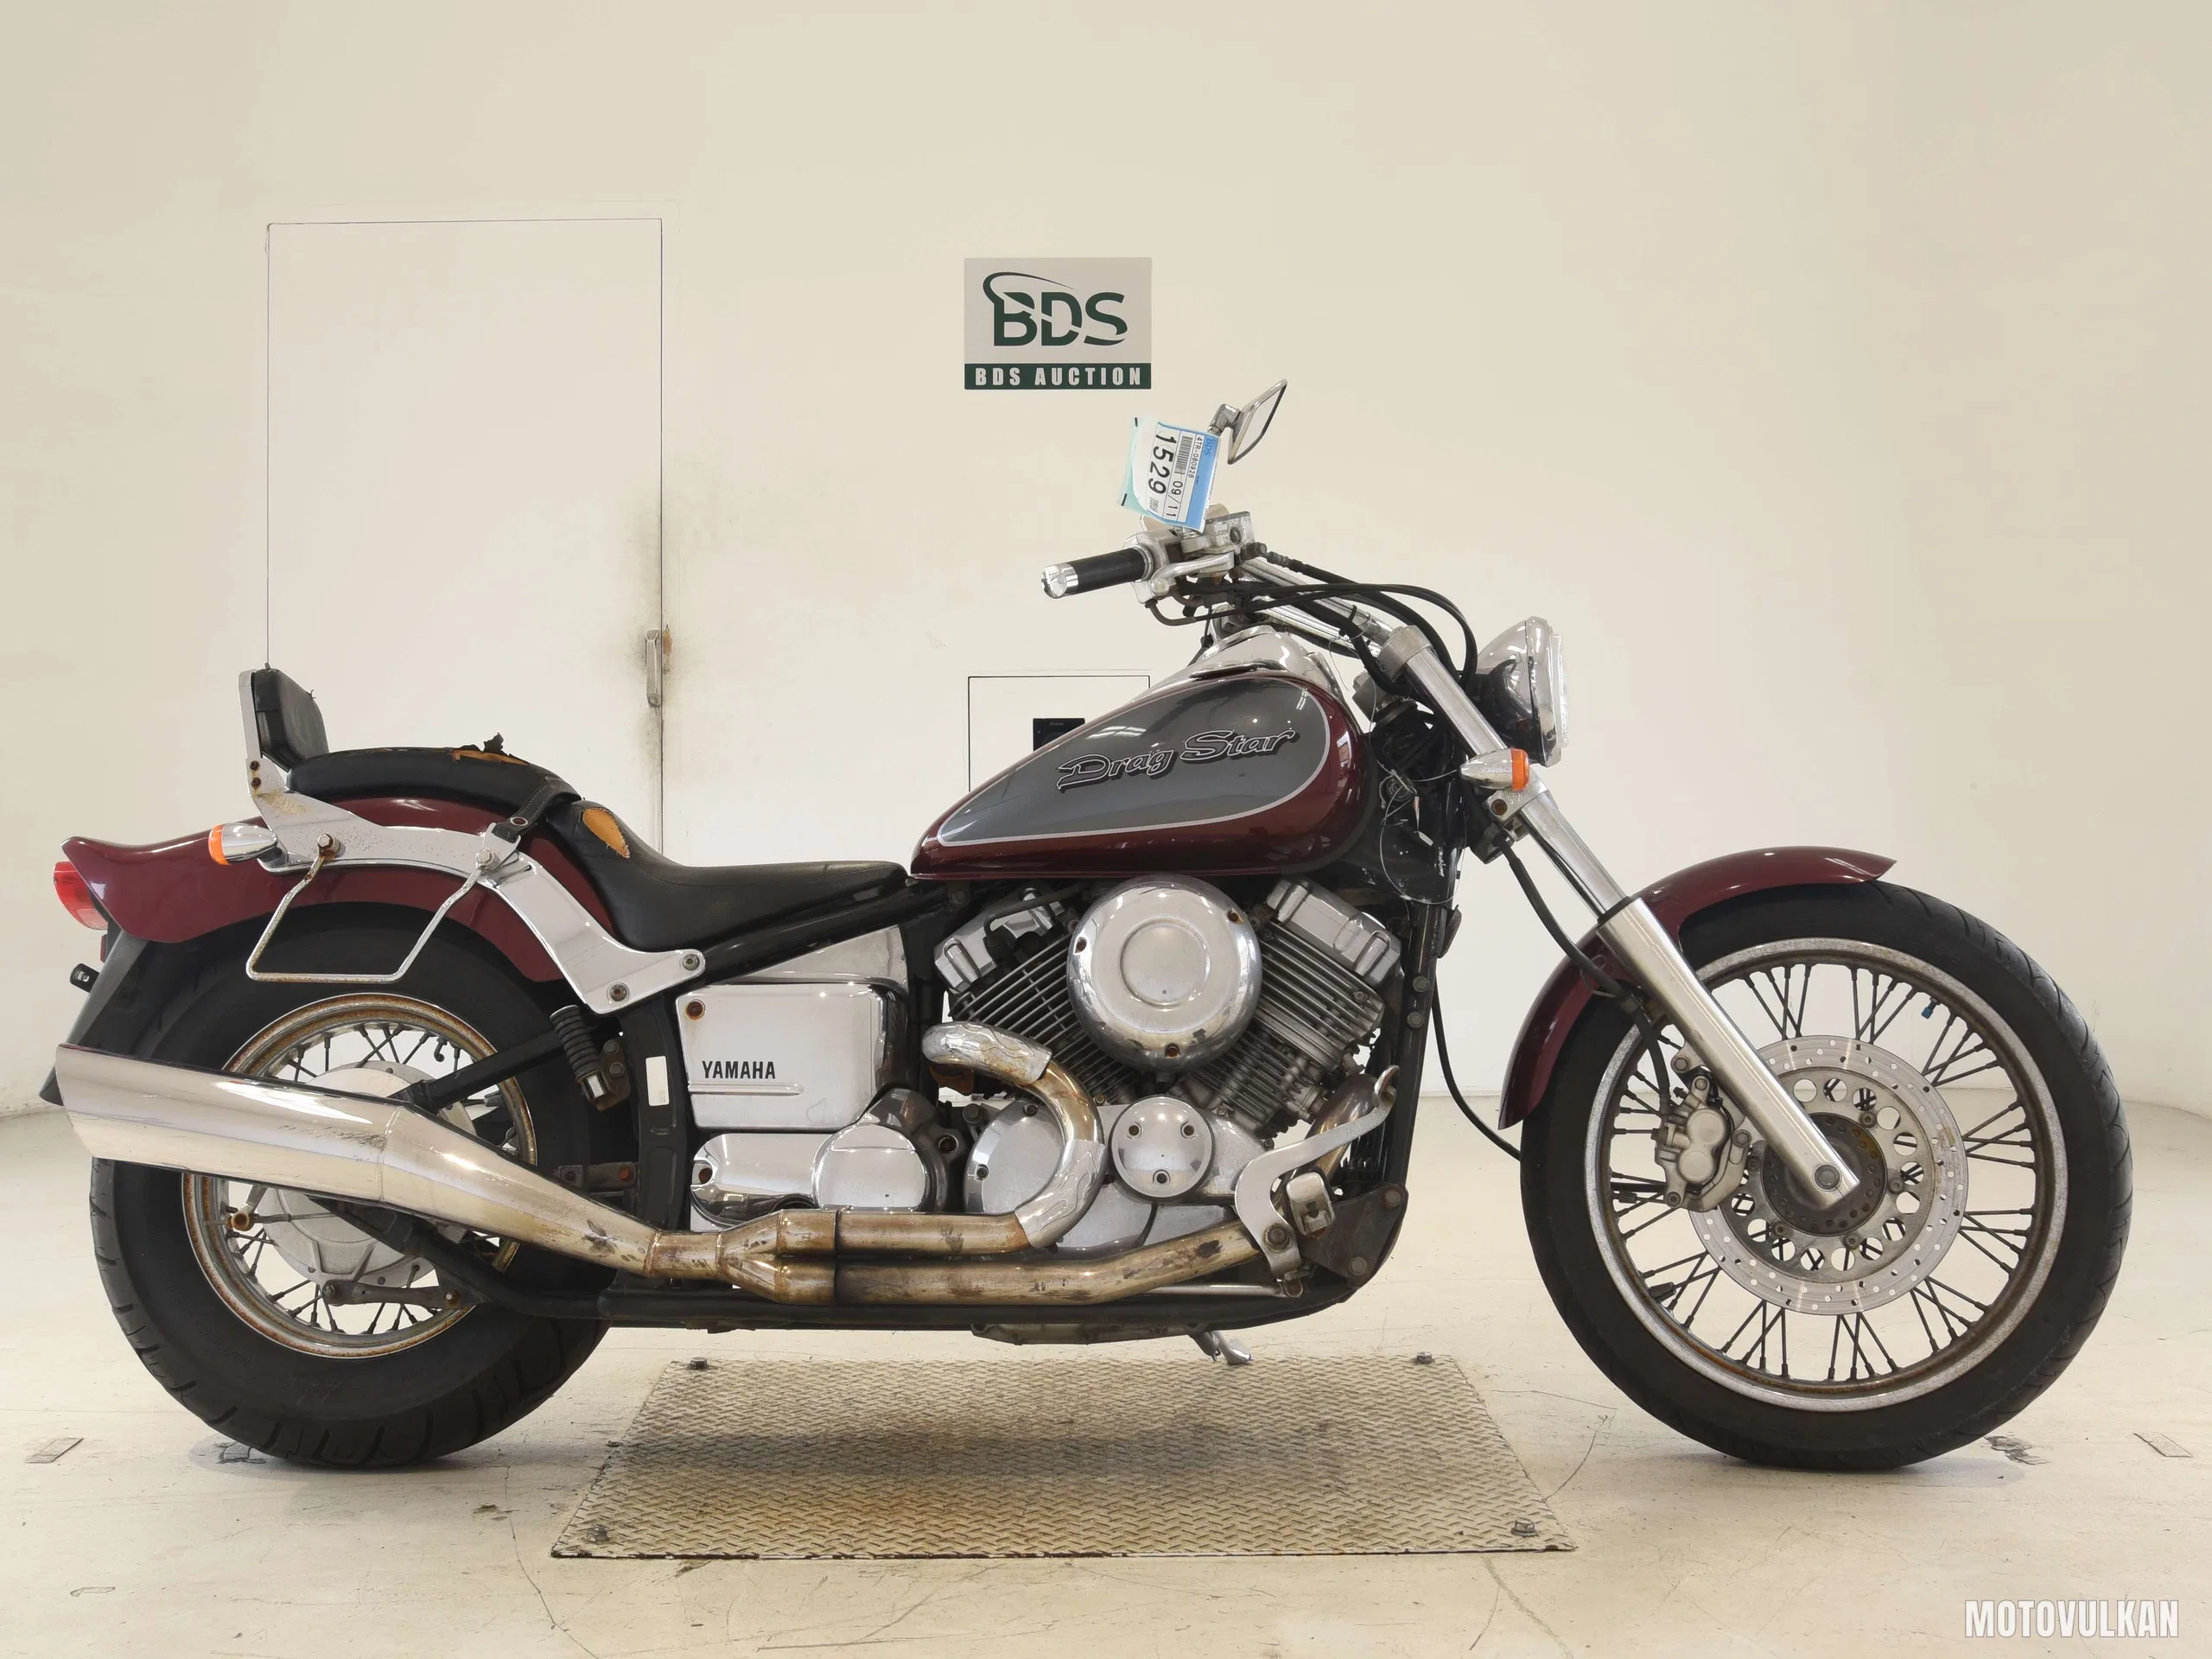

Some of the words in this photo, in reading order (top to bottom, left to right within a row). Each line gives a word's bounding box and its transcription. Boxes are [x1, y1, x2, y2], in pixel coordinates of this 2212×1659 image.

[983, 272, 1128, 346] BDS
[975, 367, 1020, 385] BDS
[1034, 367, 1141, 385] AUCTION
[1147, 434, 1177, 494] 1529
[1188, 436, 1203, 479] 4TR-080928
[1204, 438, 1215, 456] BDS
[1166, 480, 1184, 517] 09/11
[1056, 750, 1177, 792] Drag
[1180, 729, 1298, 763] Star
[702, 1061, 776, 1079] YAMAHA
